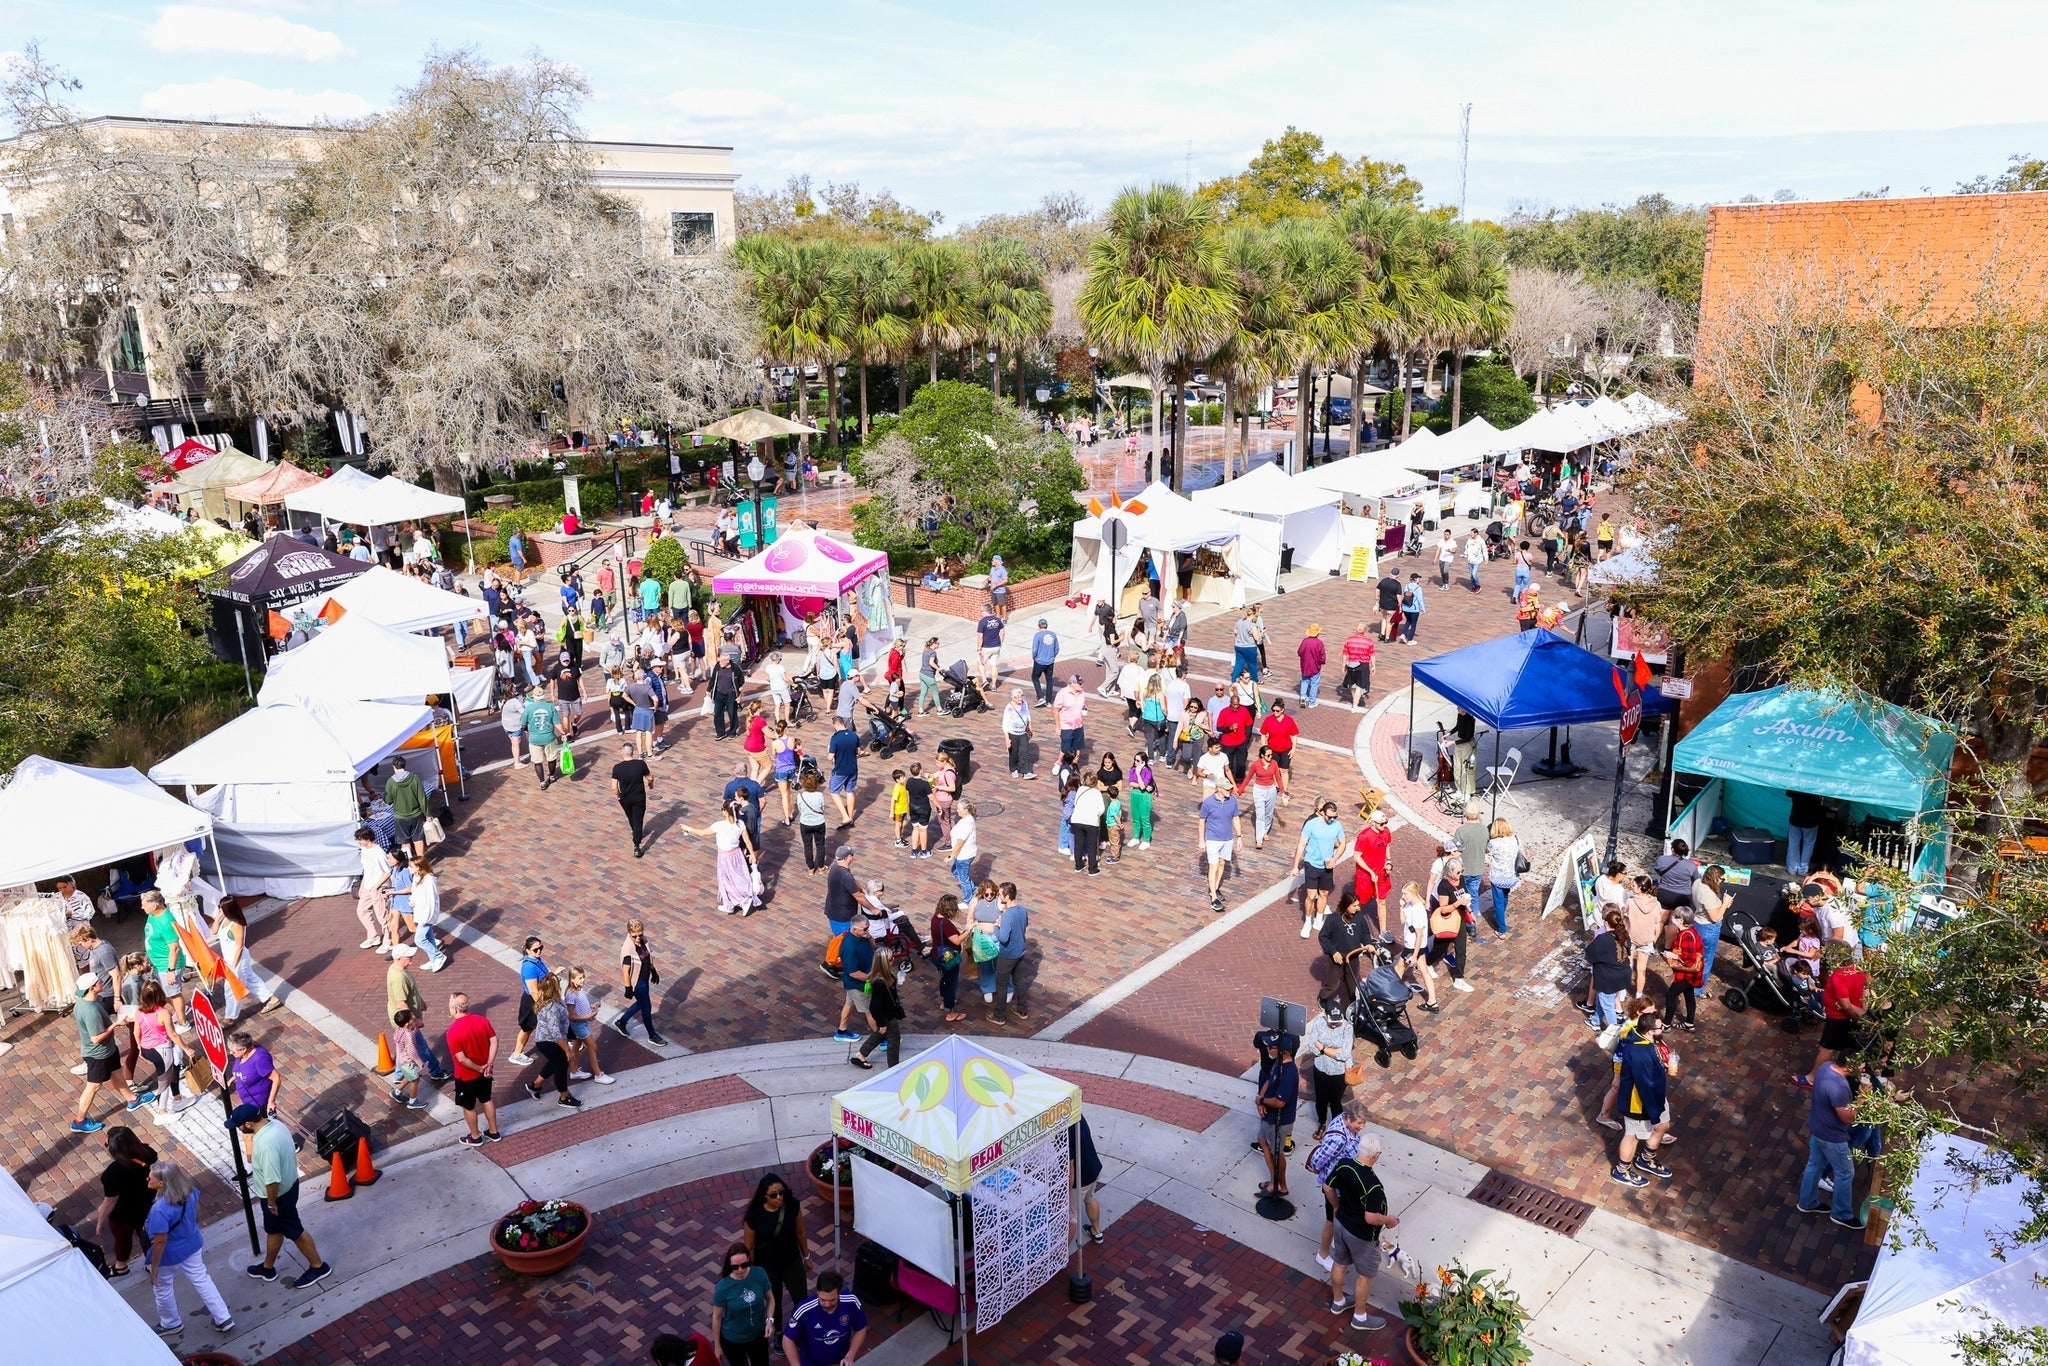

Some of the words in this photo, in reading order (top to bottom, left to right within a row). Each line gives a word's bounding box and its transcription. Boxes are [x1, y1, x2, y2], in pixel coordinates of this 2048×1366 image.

[269, 585, 286, 599] SAY
[288, 580, 316, 595] WHEN
[266, 599, 282, 609] Local
[283, 595, 301, 606] Small
[1621, 704, 1640, 730] STOP
[1753, 718, 1854, 742] Axum
[1777, 737, 1824, 748] COFFEE
[1693, 755, 1740, 770] Axum
[195, 1008, 222, 1053] STOP
